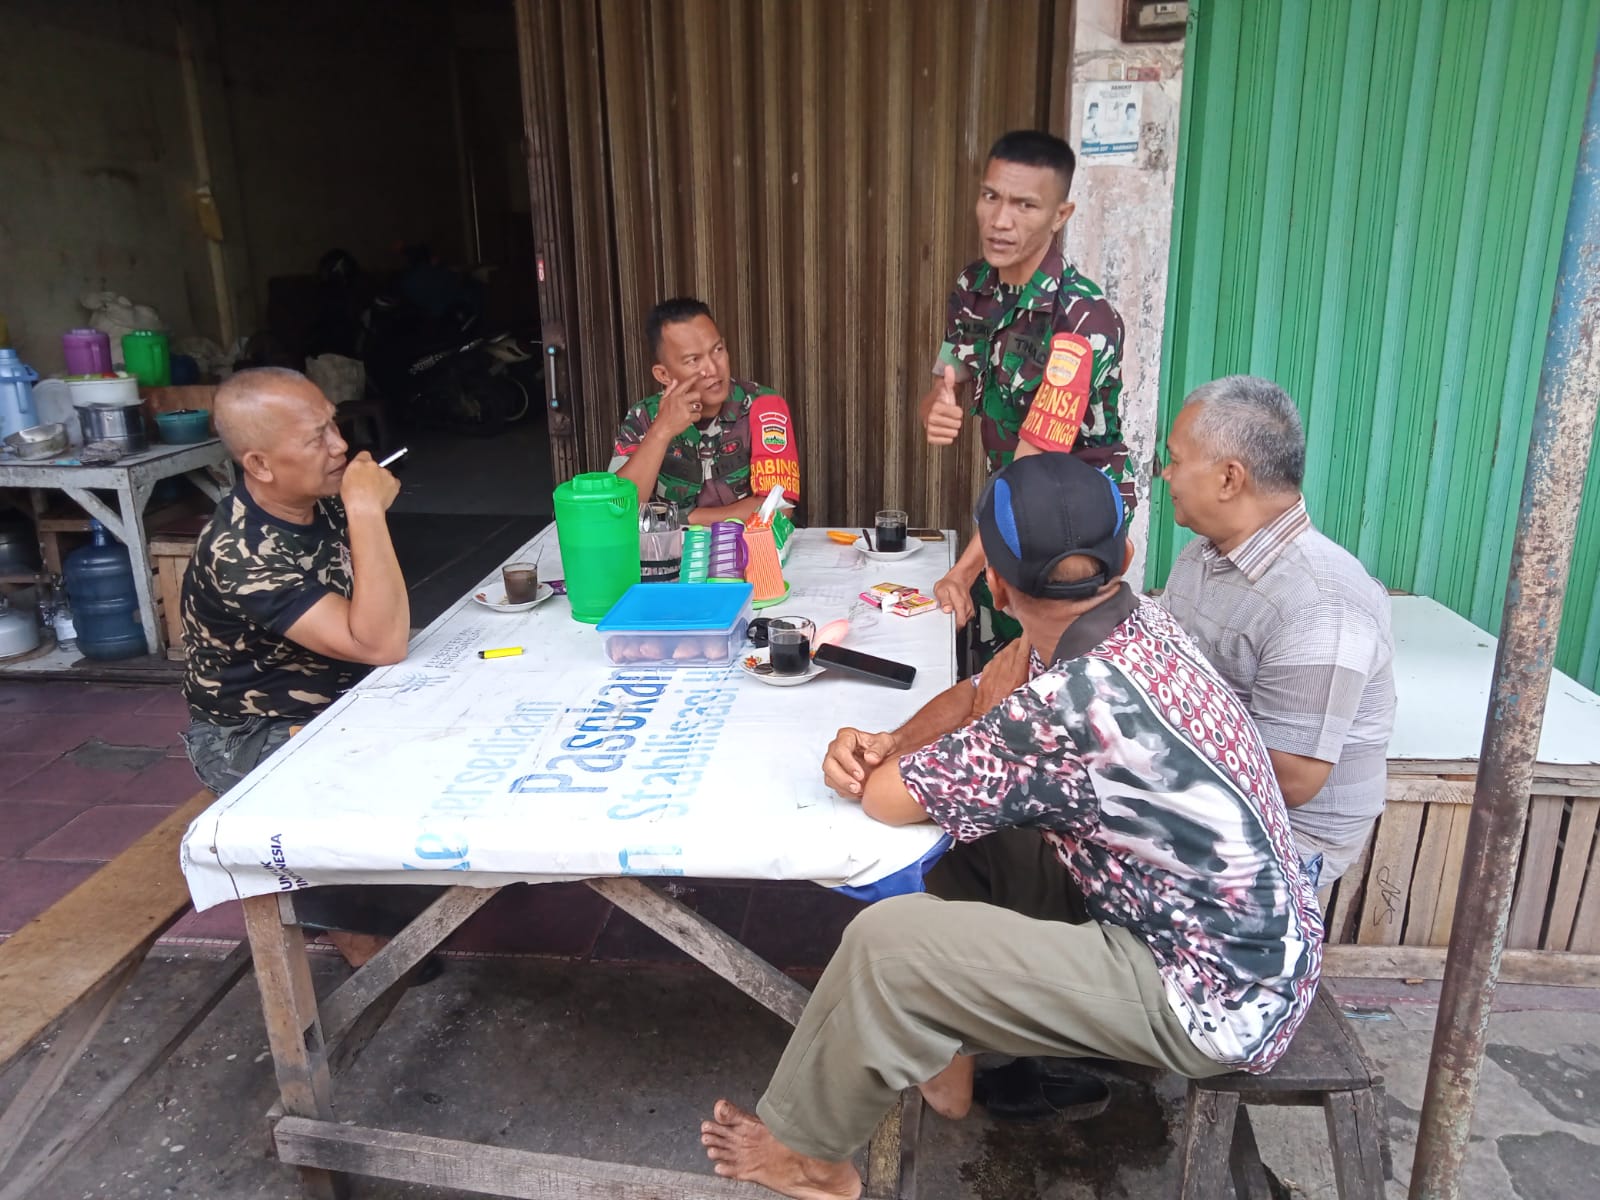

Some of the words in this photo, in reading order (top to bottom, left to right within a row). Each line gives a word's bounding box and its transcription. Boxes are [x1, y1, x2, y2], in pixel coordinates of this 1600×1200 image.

[750, 458, 800, 479] BABINS
[402, 701, 562, 871] eersediaan
[508, 667, 677, 793] Pasokan
[606, 687, 740, 821] Stabilisasi
